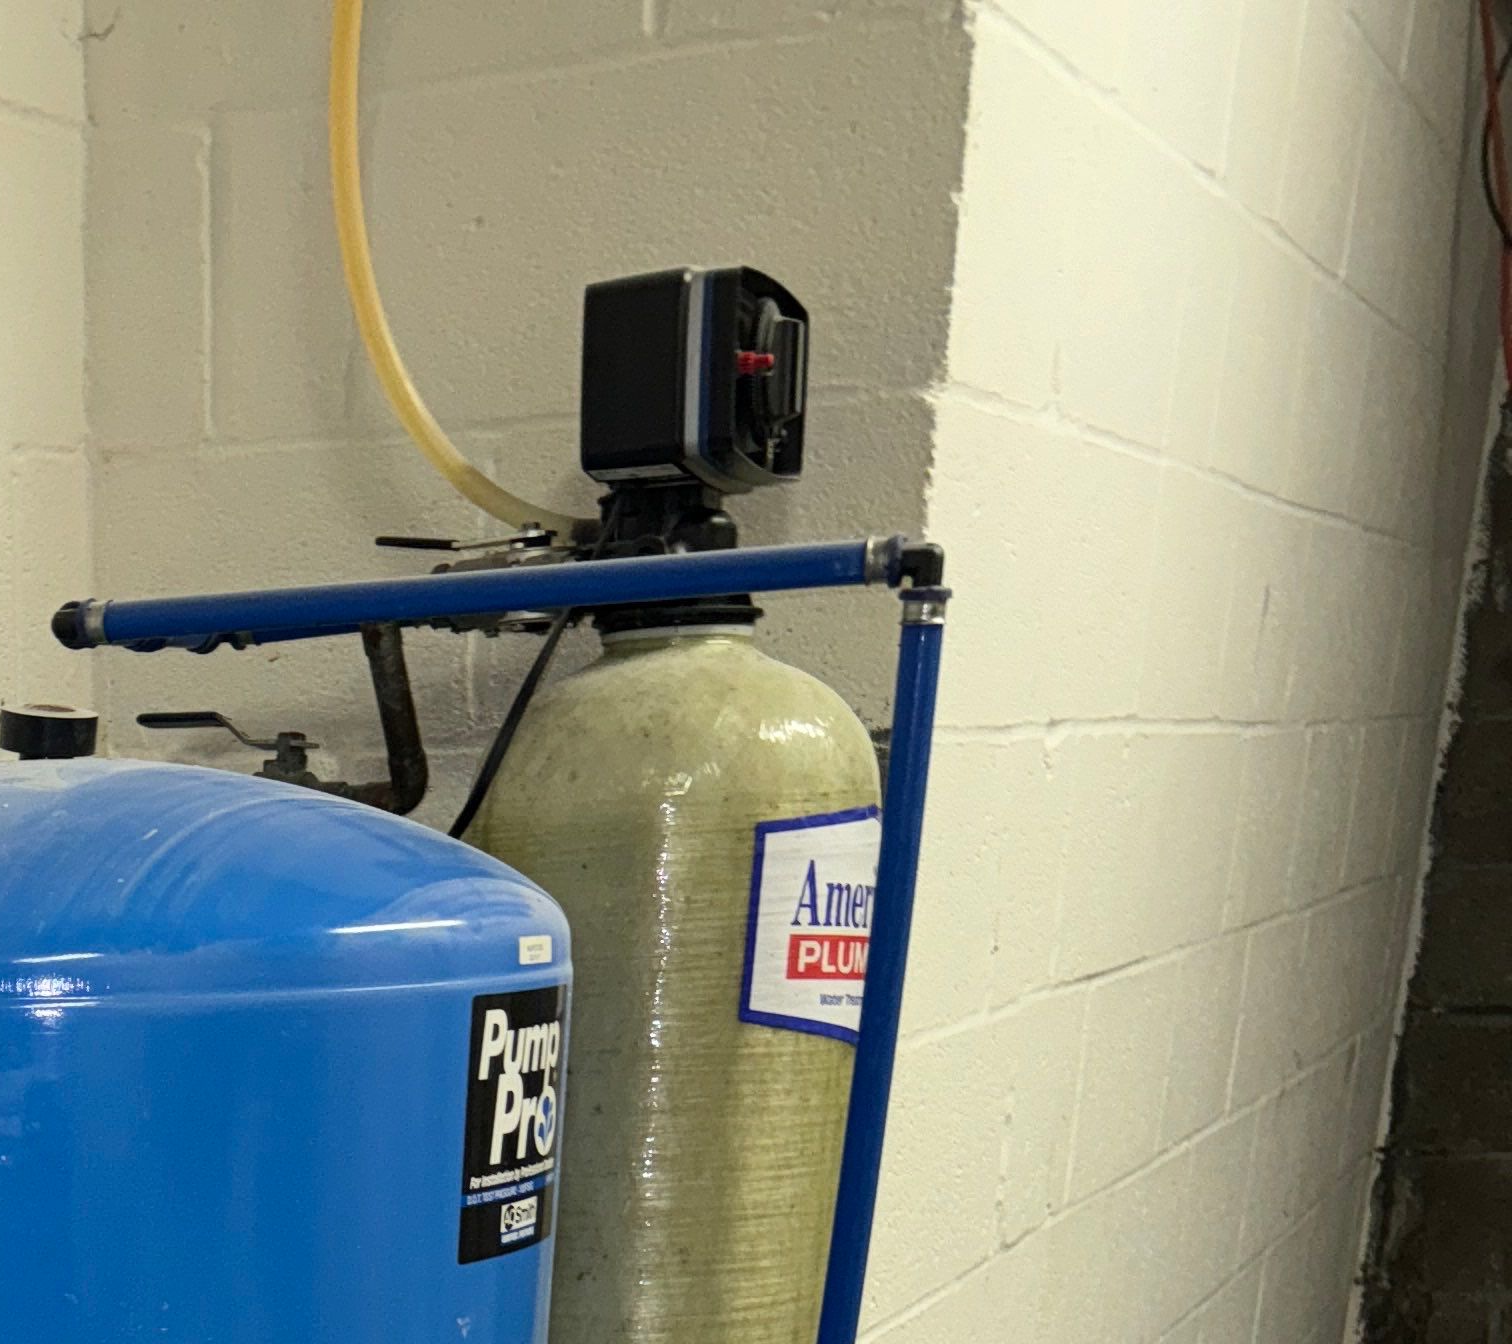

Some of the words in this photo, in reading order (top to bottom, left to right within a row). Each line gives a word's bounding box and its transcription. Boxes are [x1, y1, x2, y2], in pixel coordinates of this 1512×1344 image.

[790, 859, 876, 929] Amer
[797, 939, 870, 975] PLUM
[477, 1008, 560, 1085] Pump
[489, 1072, 557, 1166] Pro
